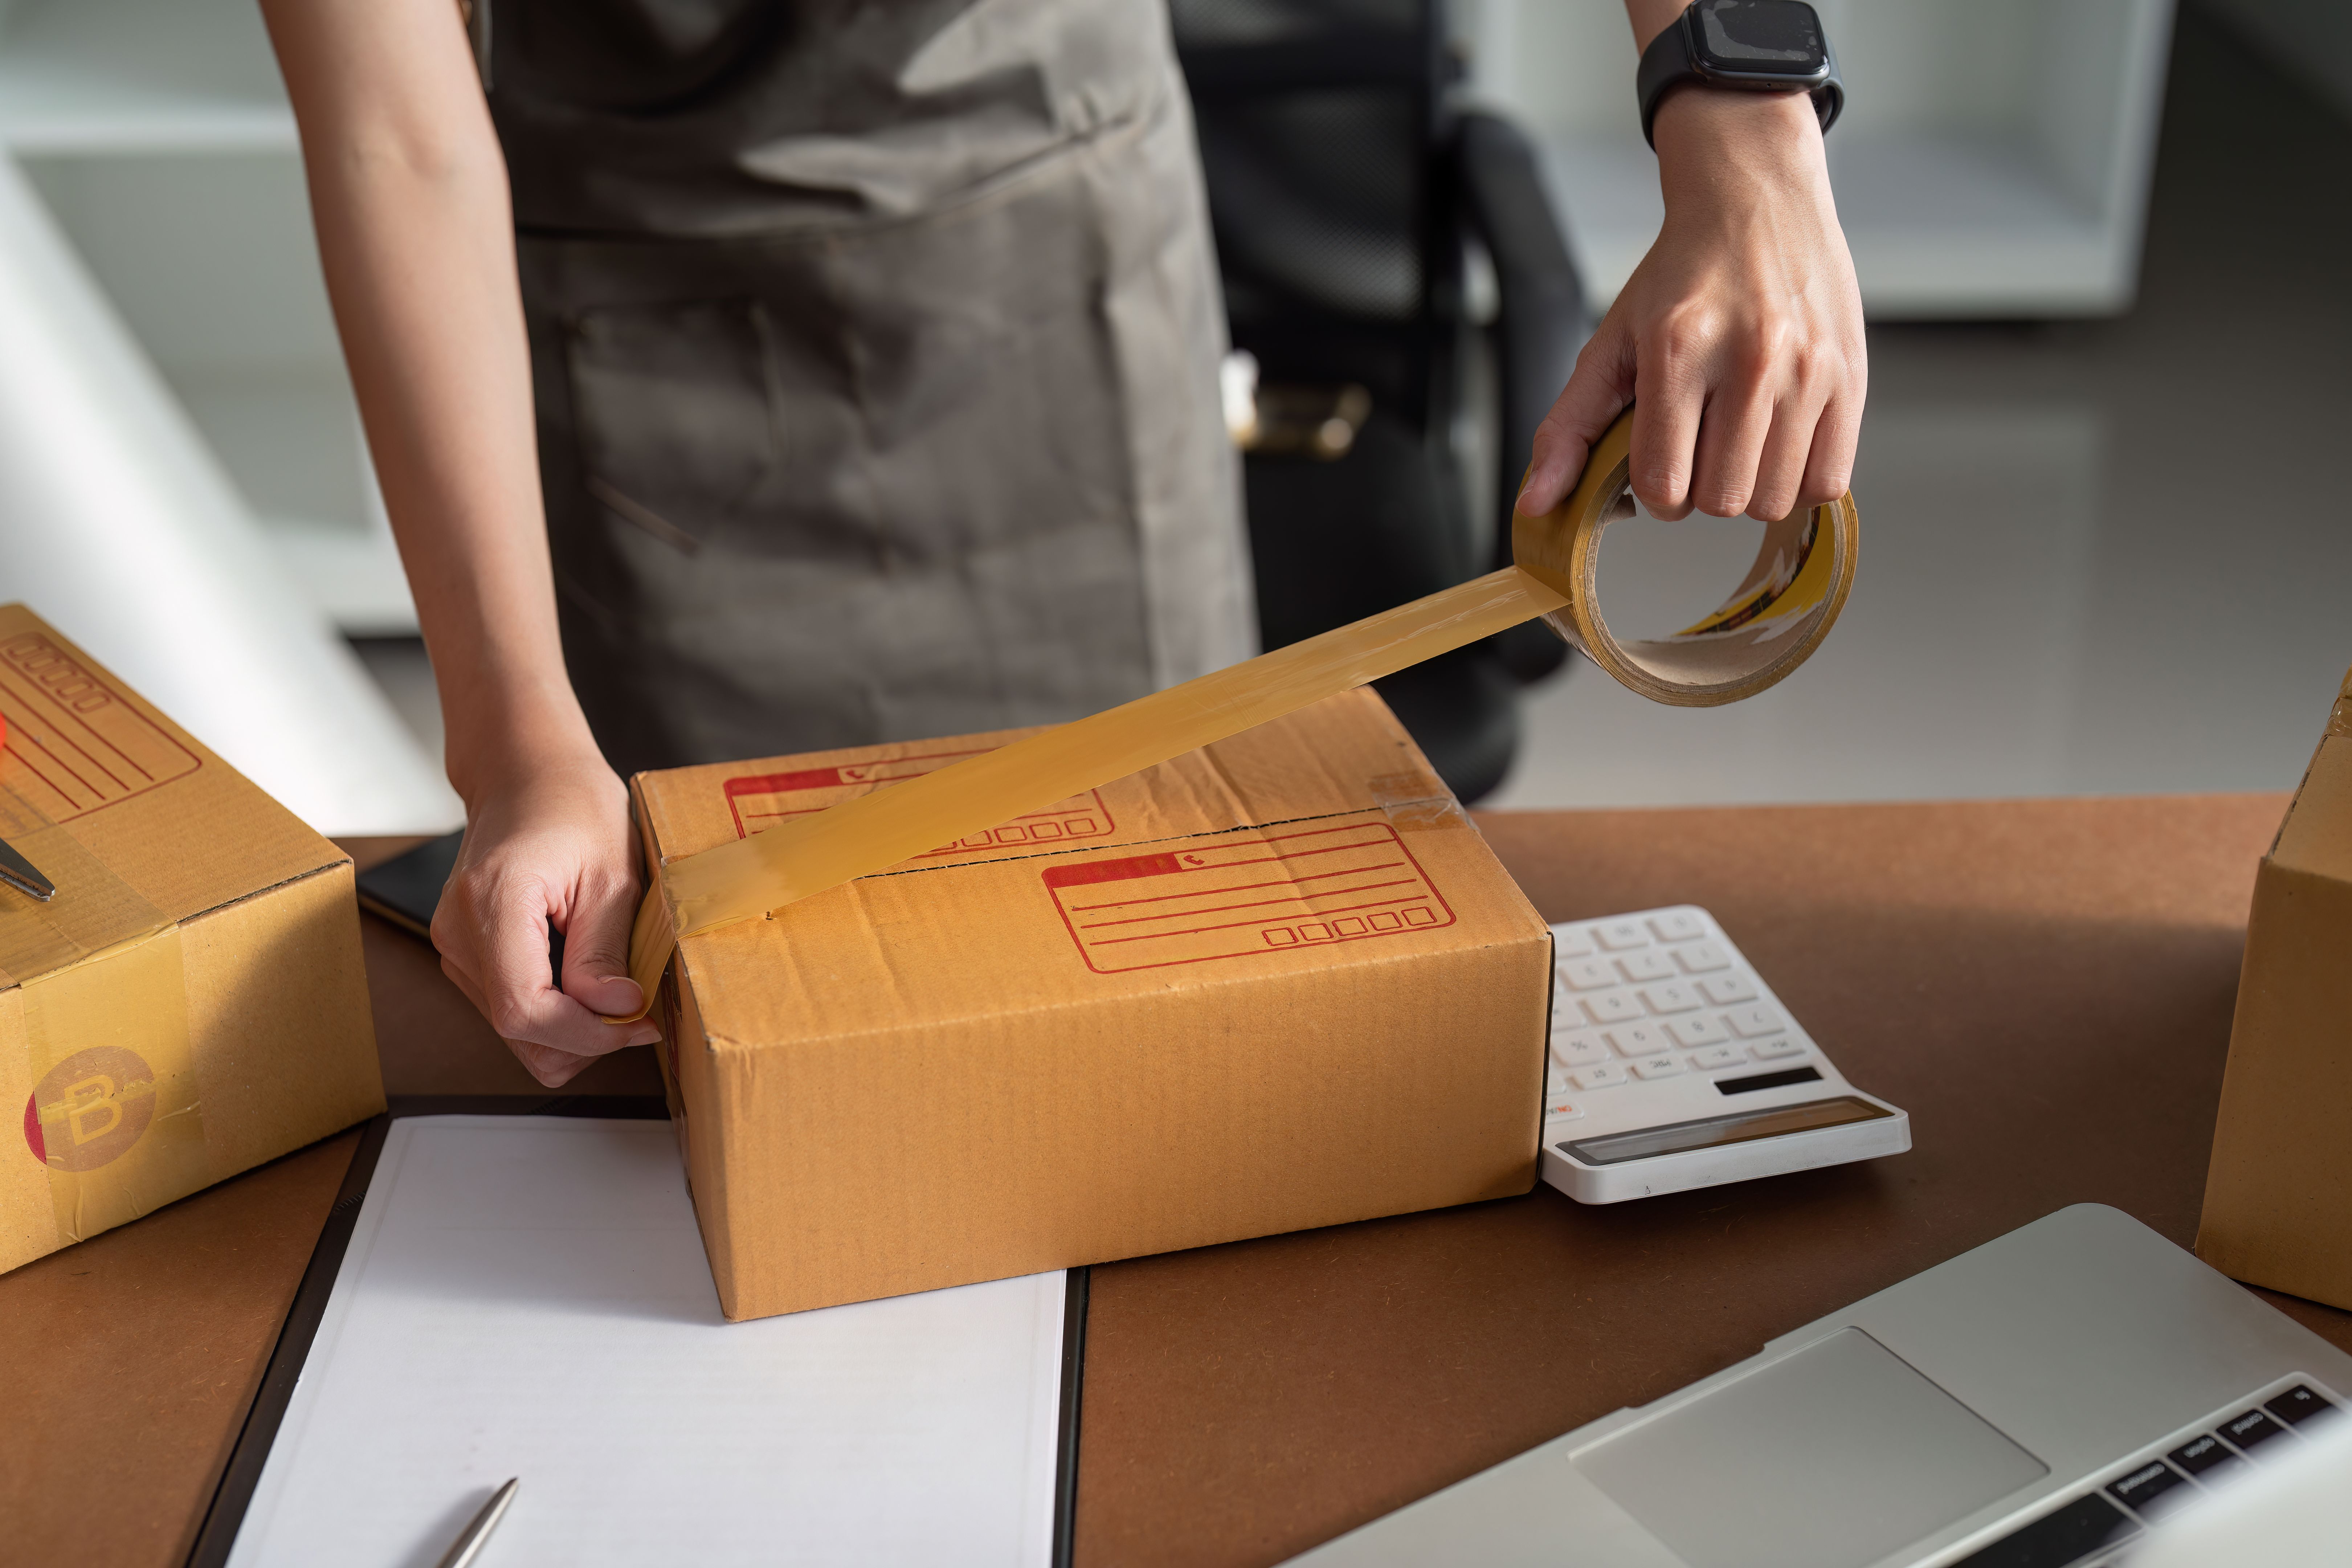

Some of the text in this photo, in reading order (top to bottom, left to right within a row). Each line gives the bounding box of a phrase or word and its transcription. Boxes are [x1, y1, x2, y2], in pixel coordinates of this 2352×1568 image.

[1753, 1011, 1764, 1024] 7
[1691, 1021, 1704, 1033] 8
[1633, 1030, 1646, 1042] 9
[1648, 1058, 1672, 1069] MRC
[1593, 1069, 1607, 1079] GT
[65, 1075, 122, 1146] B
